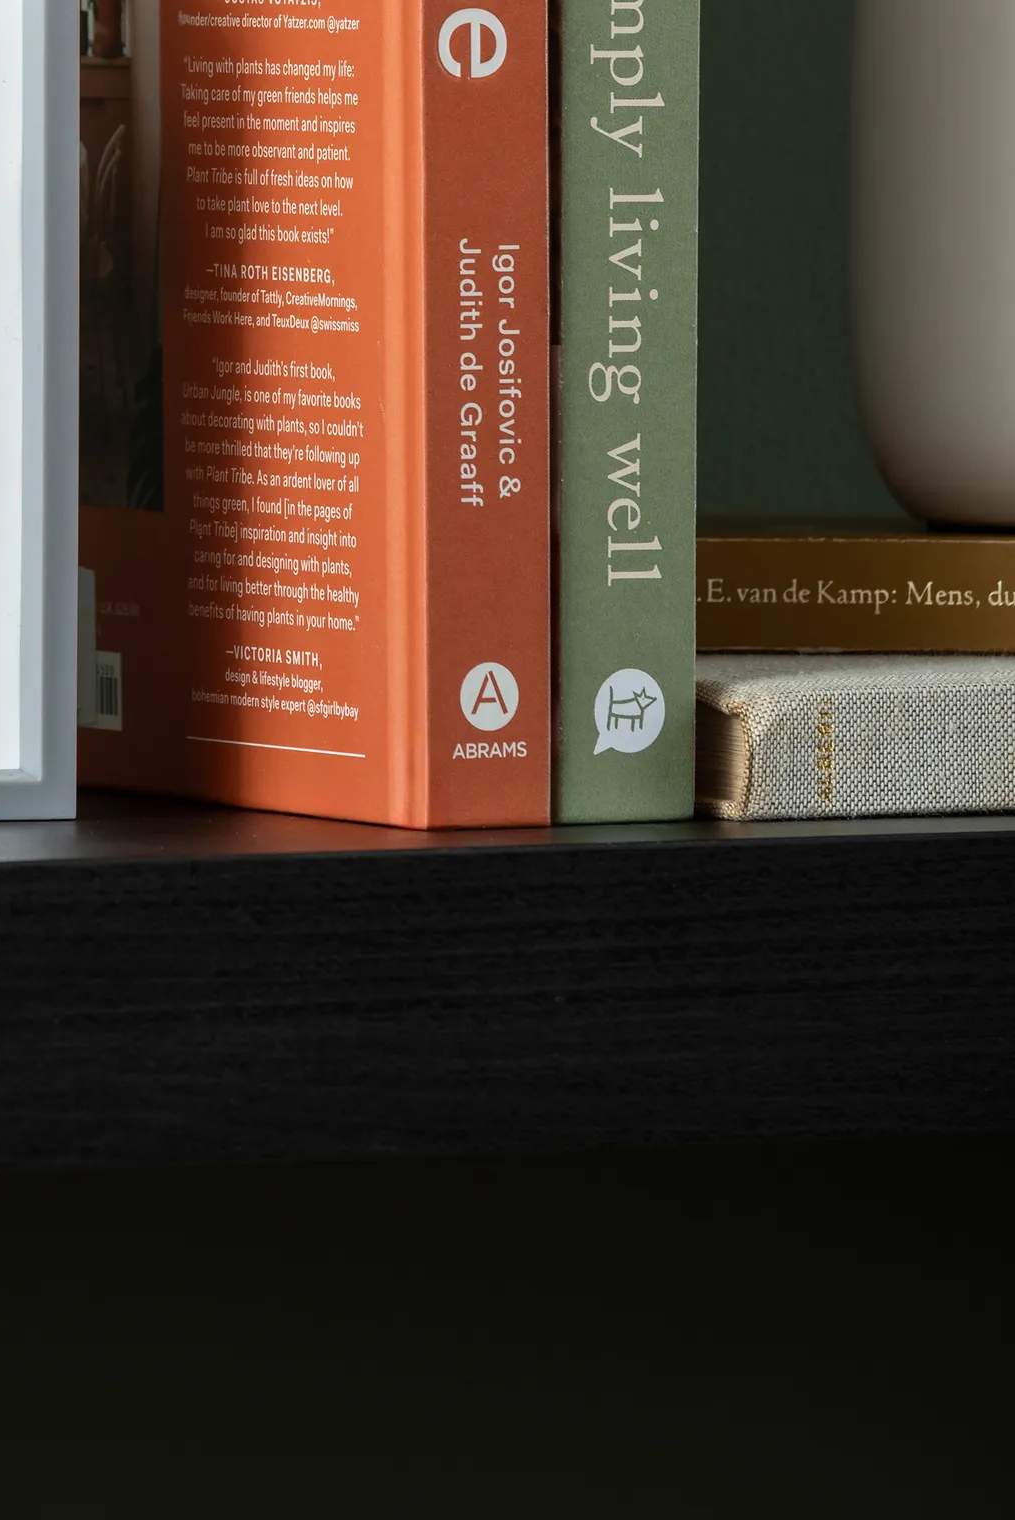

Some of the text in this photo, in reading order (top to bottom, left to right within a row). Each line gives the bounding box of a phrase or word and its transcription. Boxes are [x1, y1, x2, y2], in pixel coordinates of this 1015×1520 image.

[216, 57, 233, 73] with
[237, 58, 263, 77] plants
[266, 58, 280, 75] has
[283, 60, 320, 80] changed
[323, 65, 336, 81] my
[339, 60, 354, 77] life:
[242, 265, 268, 280] ROTH
[272, 267, 334, 286] EISENBERG,
[589, 188, 664, 404] living
[236, 358, 252, 376] and
[254, 360, 288, 377] Judith’s
[290, 361, 308, 378] first
[311, 362, 335, 382] book,
[460, 238, 483, 506] Judith de Graaff
[492, 245, 521, 498] Igor Josifovic &
[607, 433, 662, 586] well
[737, 588, 777, 603] van
[783, 579, 810, 603] de
[818, 581, 896, 614] Kamp:
[906, 581, 980, 608] Mens,
[286, 650, 322, 670] SMITH,
[225, 669, 323, 693] design & lifestyle blogger,
[453, 741, 527, 759] ABRAMS
